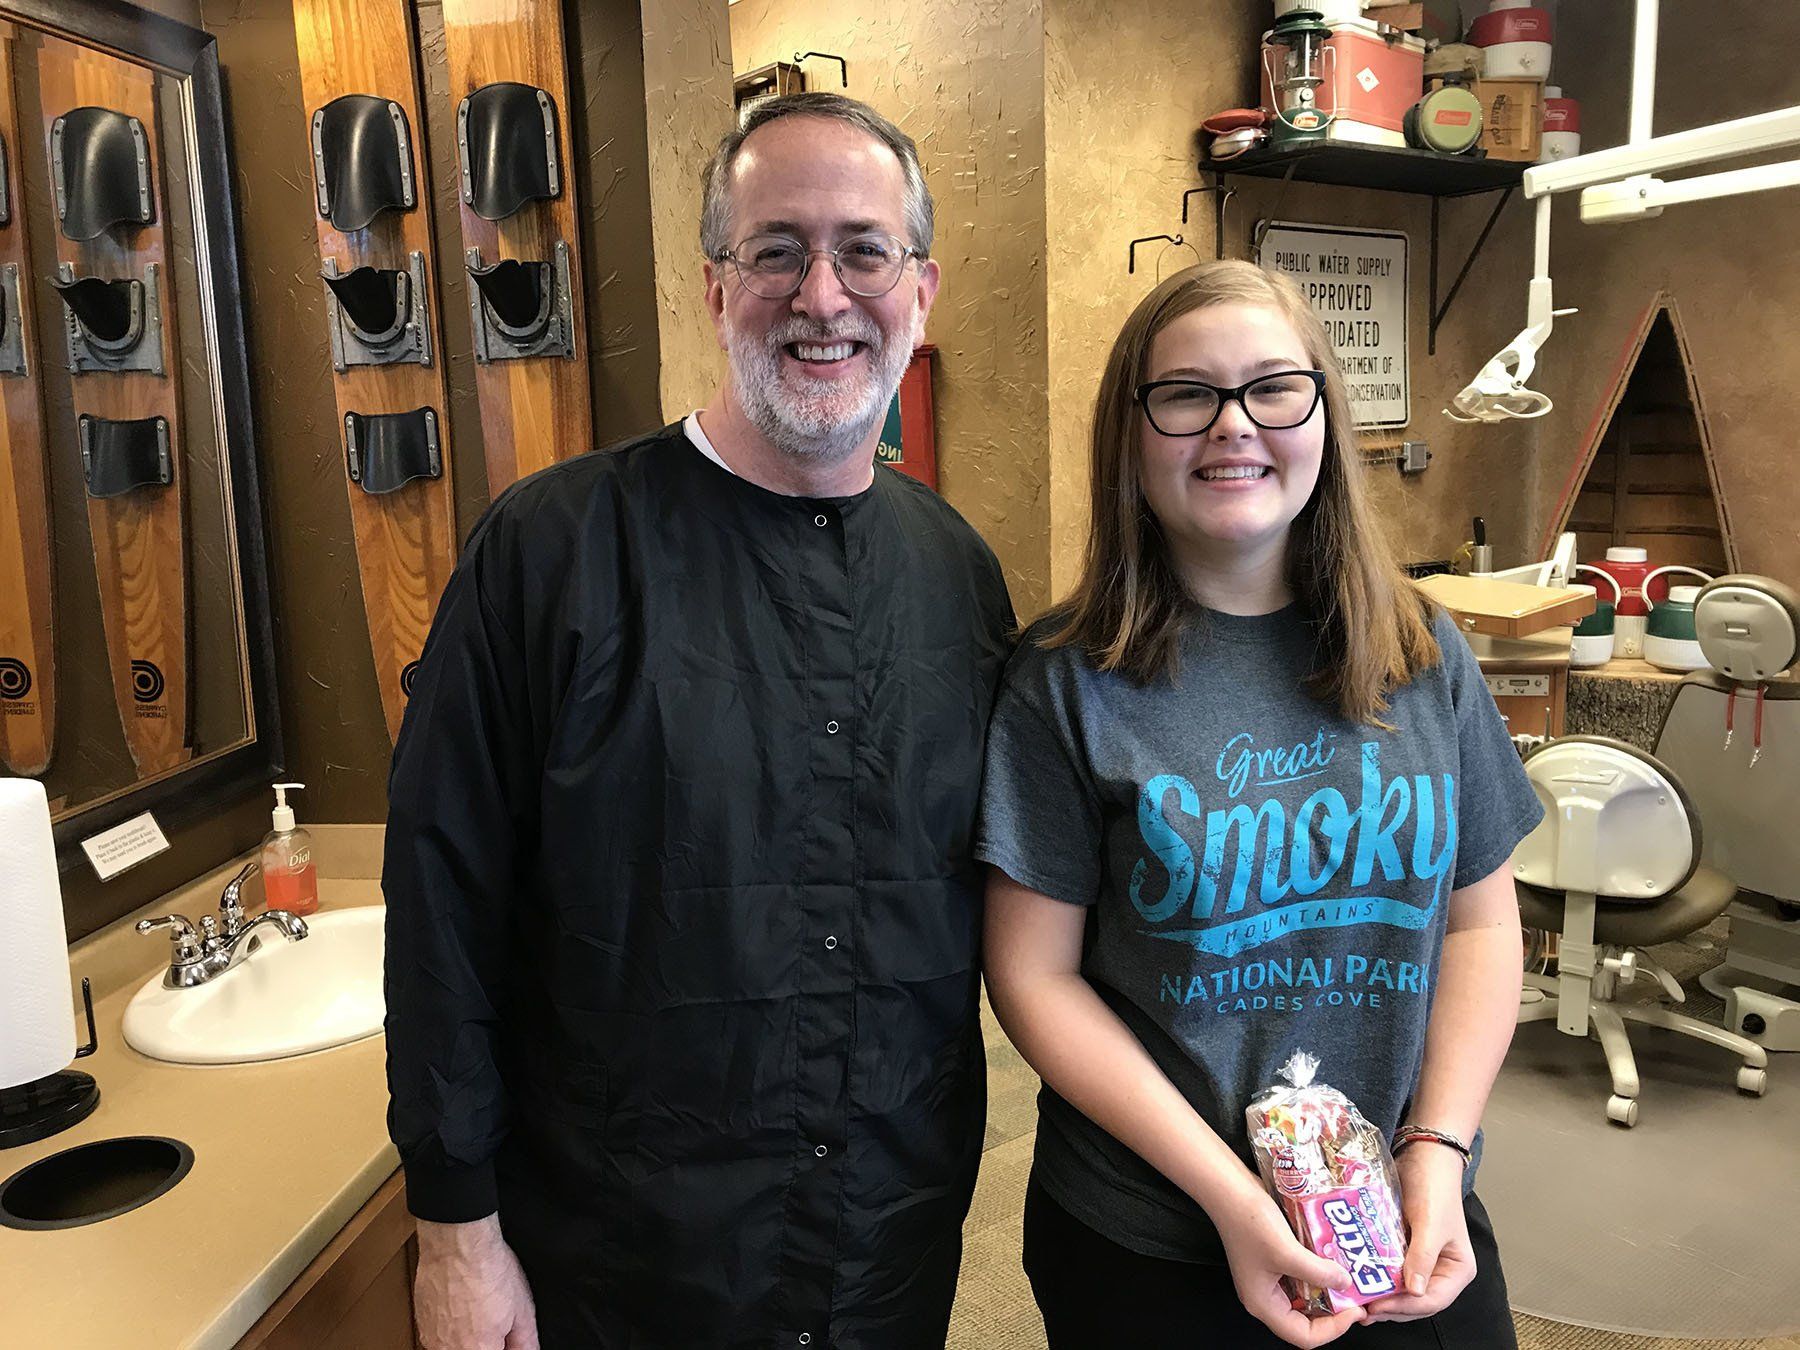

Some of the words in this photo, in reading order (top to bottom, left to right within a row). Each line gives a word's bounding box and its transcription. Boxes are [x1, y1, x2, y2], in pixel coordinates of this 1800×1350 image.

[1275, 252, 1311, 273] PUBLIC
[1319, 254, 1350, 275] WATER
[1357, 257, 1392, 277] SUPPLY
[1301, 282, 1372, 311] PPROVED
[1382, 356, 1393, 374] OF
[1346, 383, 1402, 401] ONSERVATION
[1216, 727, 1336, 798] Great
[1129, 741, 1456, 924] Smoky
[288, 849, 310, 867] Dial
[1225, 902, 1375, 946] MOUNTAINS
[1160, 957, 1333, 1005] NATIONAL
[1217, 996, 1304, 1014] CADES
[1315, 991, 1381, 1009] COVE
[1322, 1198, 1396, 1297] Extra
